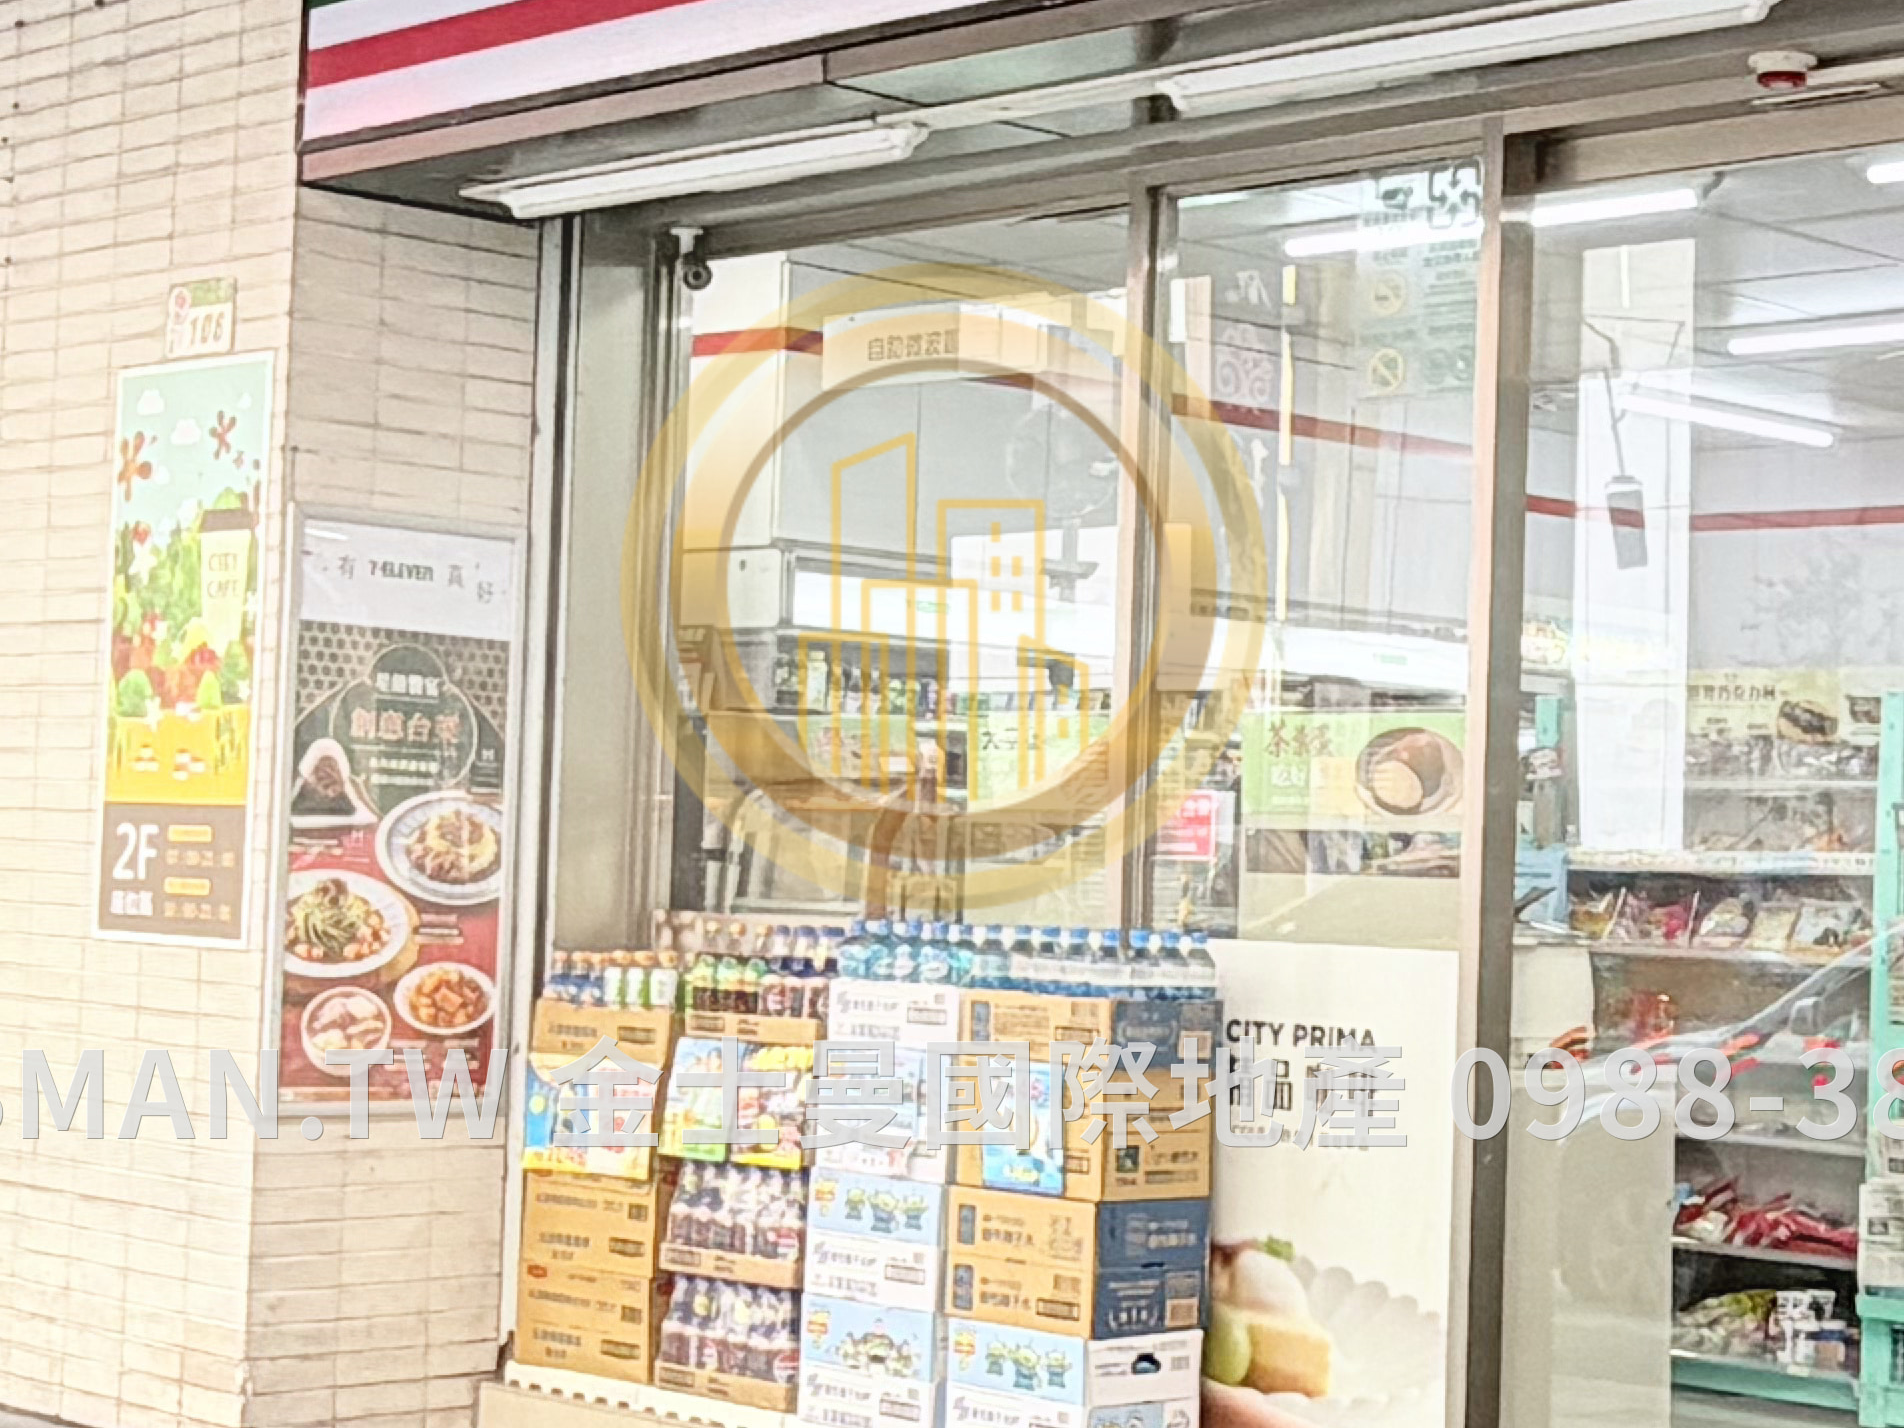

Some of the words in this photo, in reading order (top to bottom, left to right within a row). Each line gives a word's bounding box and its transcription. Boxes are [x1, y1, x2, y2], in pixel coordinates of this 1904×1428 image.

[112, 822, 160, 880] 2F
[1226, 1019, 1285, 1047] CITY
[1293, 1023, 1376, 1052] PRIMA
